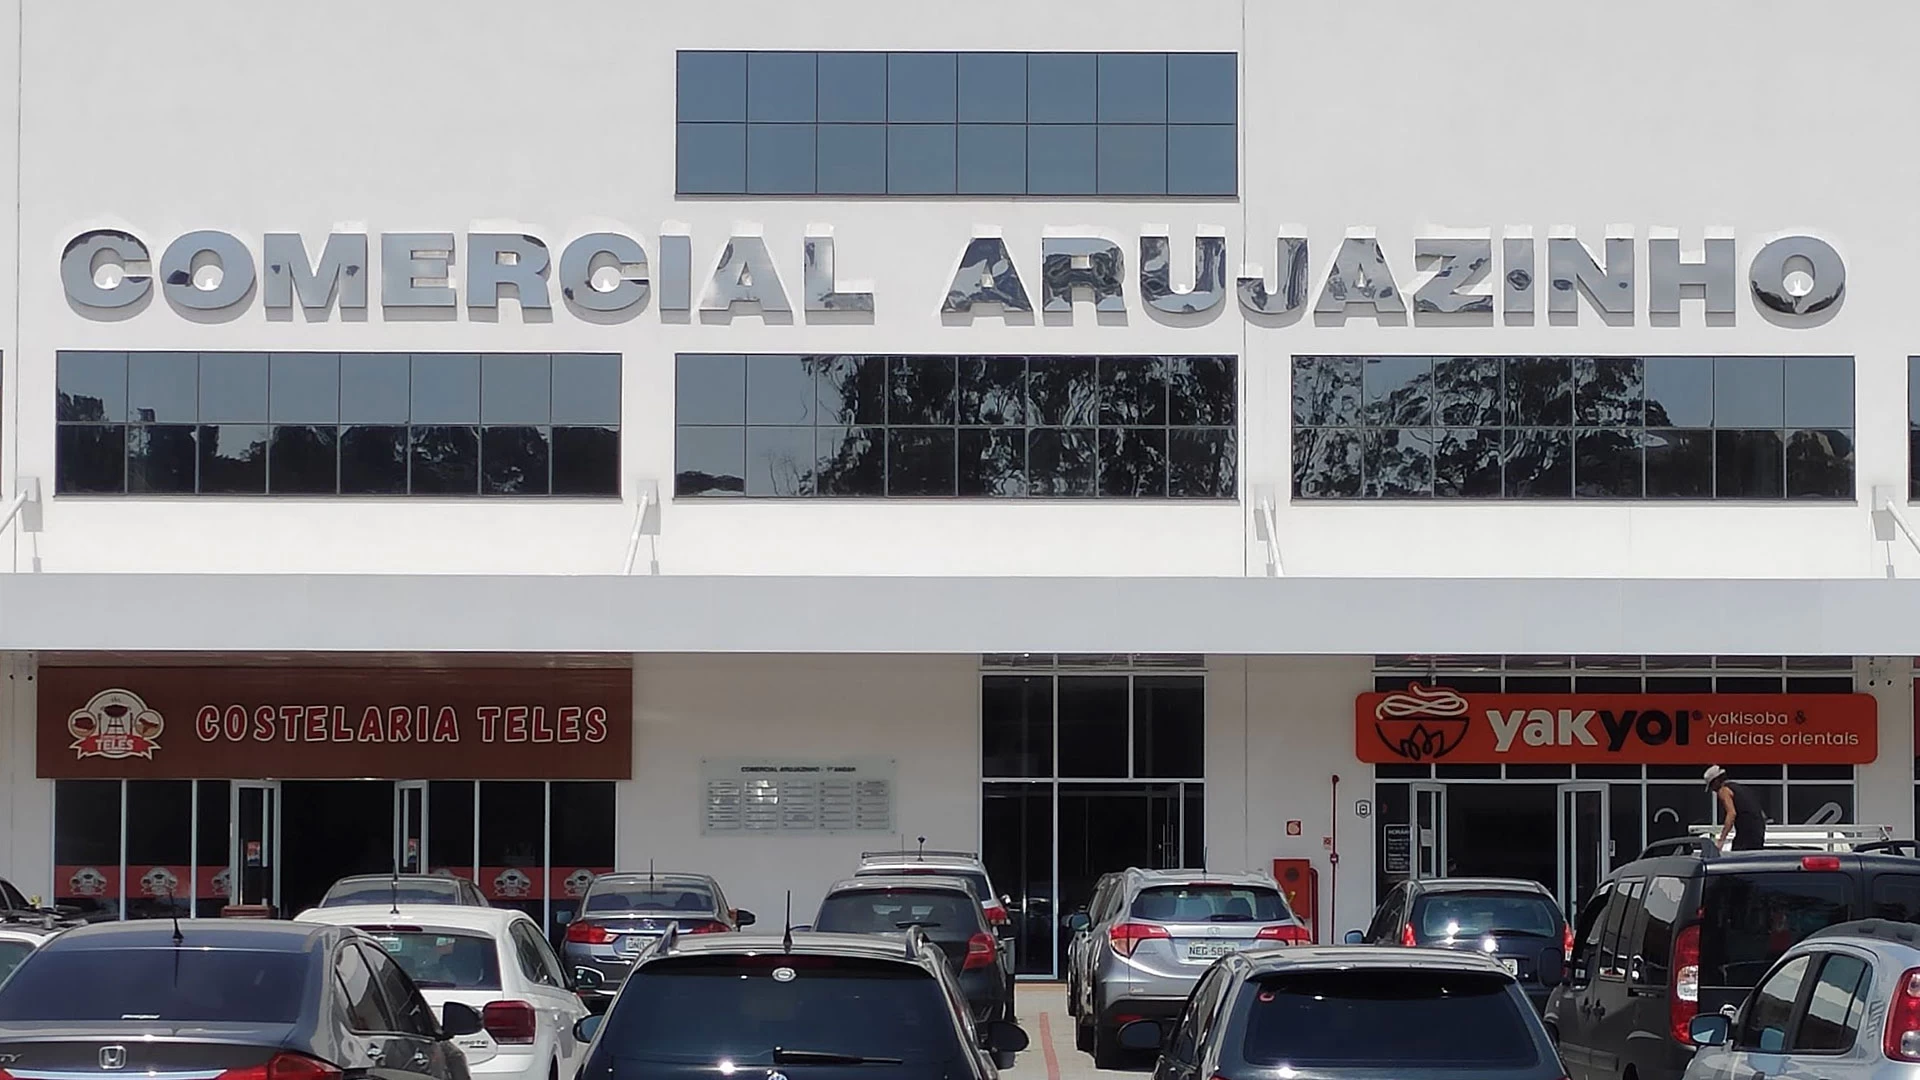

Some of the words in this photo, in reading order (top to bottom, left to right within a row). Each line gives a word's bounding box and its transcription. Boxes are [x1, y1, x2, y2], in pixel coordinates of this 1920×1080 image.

[60, 228, 875, 324] COMERCIAL
[940, 233, 1847, 328] ARUJAZINHO
[196, 704, 459, 742] COSTELARIA
[477, 706, 608, 744] TELES
[1707, 710, 1789, 727] yakisoba
[95, 739, 134, 751] TELES
[1706, 731, 1775, 746] delícias
[1780, 731, 1859, 746] orientais
